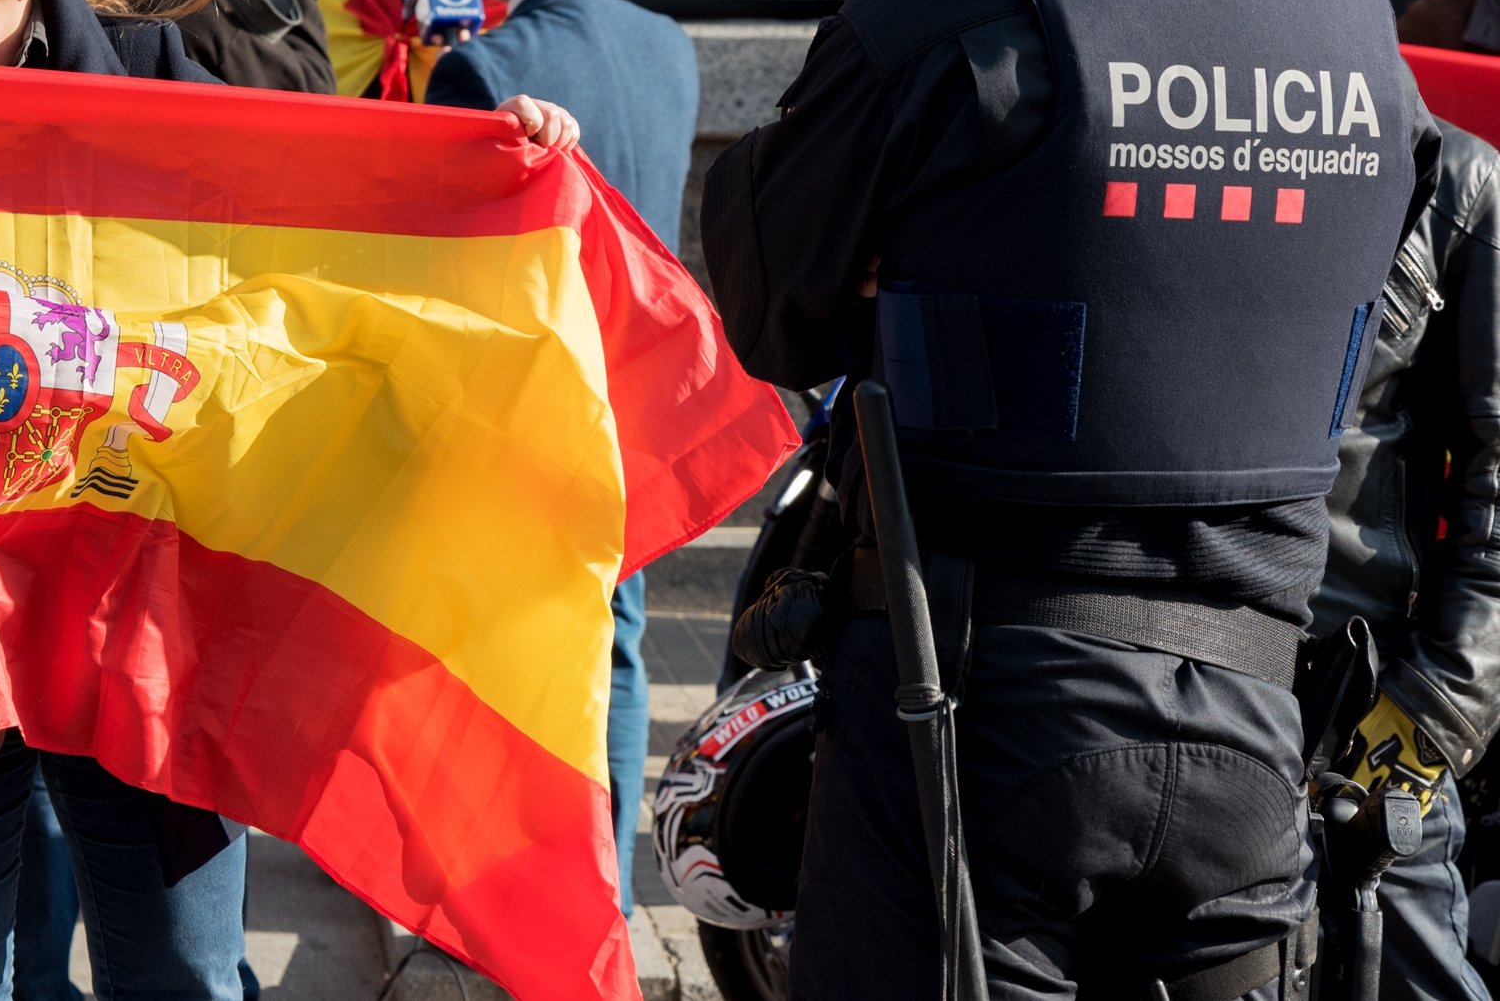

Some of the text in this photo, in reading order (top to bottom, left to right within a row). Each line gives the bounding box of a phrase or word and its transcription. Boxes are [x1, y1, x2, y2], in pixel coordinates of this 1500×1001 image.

[1108, 61, 1381, 138] POLICIA
[1109, 143, 1225, 171] mossos
[134, 347, 192, 384] VLTRA
[713, 706, 759, 745] WILD
